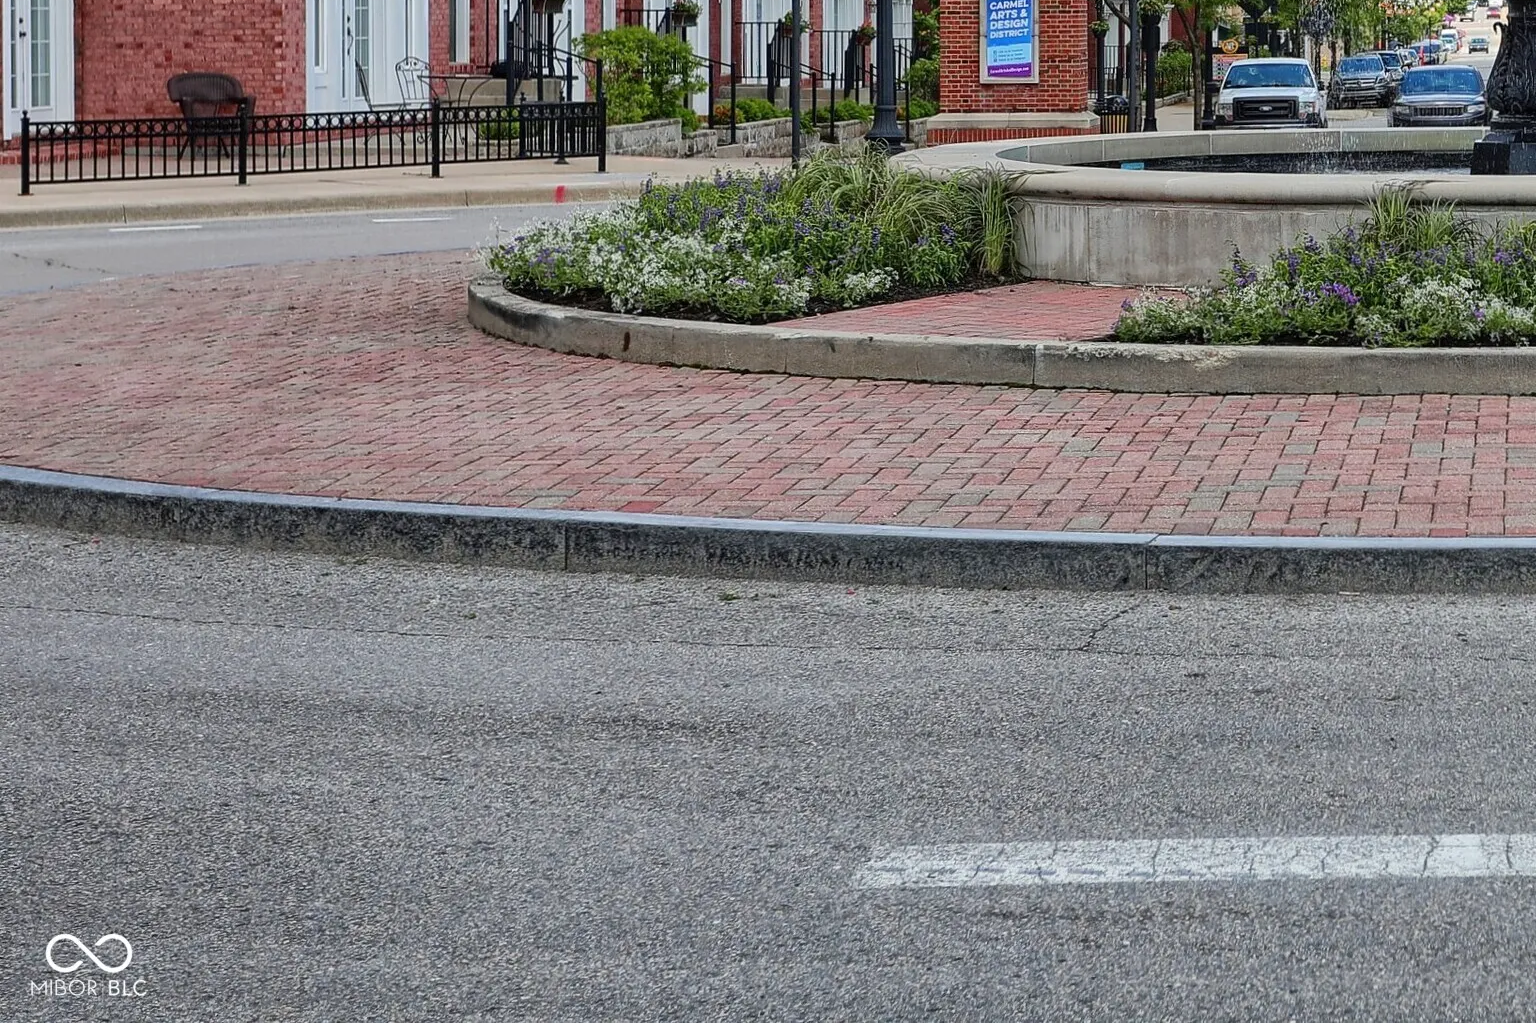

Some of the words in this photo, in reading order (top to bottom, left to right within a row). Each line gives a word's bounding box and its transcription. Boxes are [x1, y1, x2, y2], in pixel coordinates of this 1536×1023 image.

[989, 0, 1029, 10] CARMEL
[990, 10, 1018, 20] ARTS
[1020, 9, 1028, 18] &
[990, 18, 1029, 30] DESIGN
[990, 29, 1029, 39] DISTRICT
